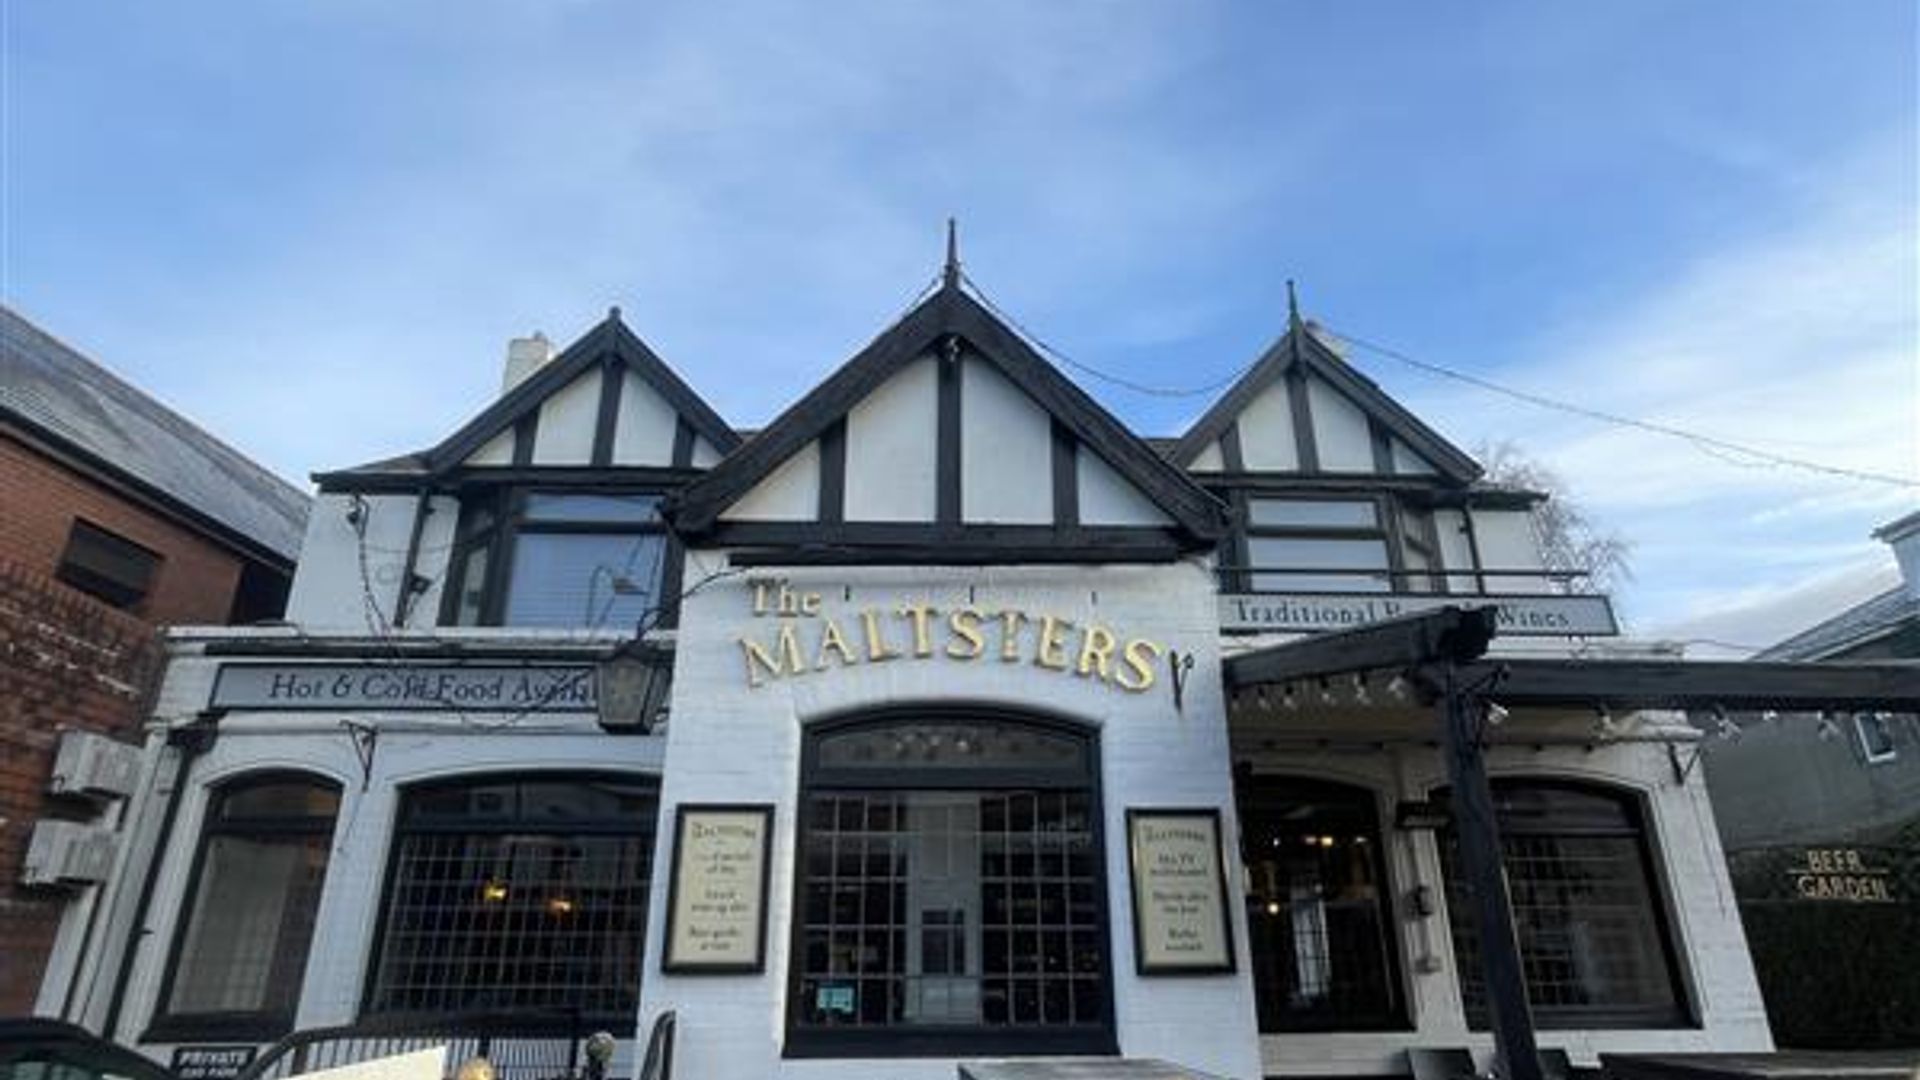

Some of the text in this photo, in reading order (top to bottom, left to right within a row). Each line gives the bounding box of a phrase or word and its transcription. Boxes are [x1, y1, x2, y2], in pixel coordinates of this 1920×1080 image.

[745, 577, 822, 617] The
[1229, 599, 1376, 623] Traditional
[1497, 603, 1569, 626] Wines
[737, 603, 1161, 692] MALTSTERS
[268, 673, 324, 699] Hot
[331, 673, 353, 699] &
[435, 673, 504, 700] Food
[1806, 850, 1865, 873] BEER
[1798, 875, 1891, 901] GARDEN
[179, 1050, 250, 1067] PRIVATE
